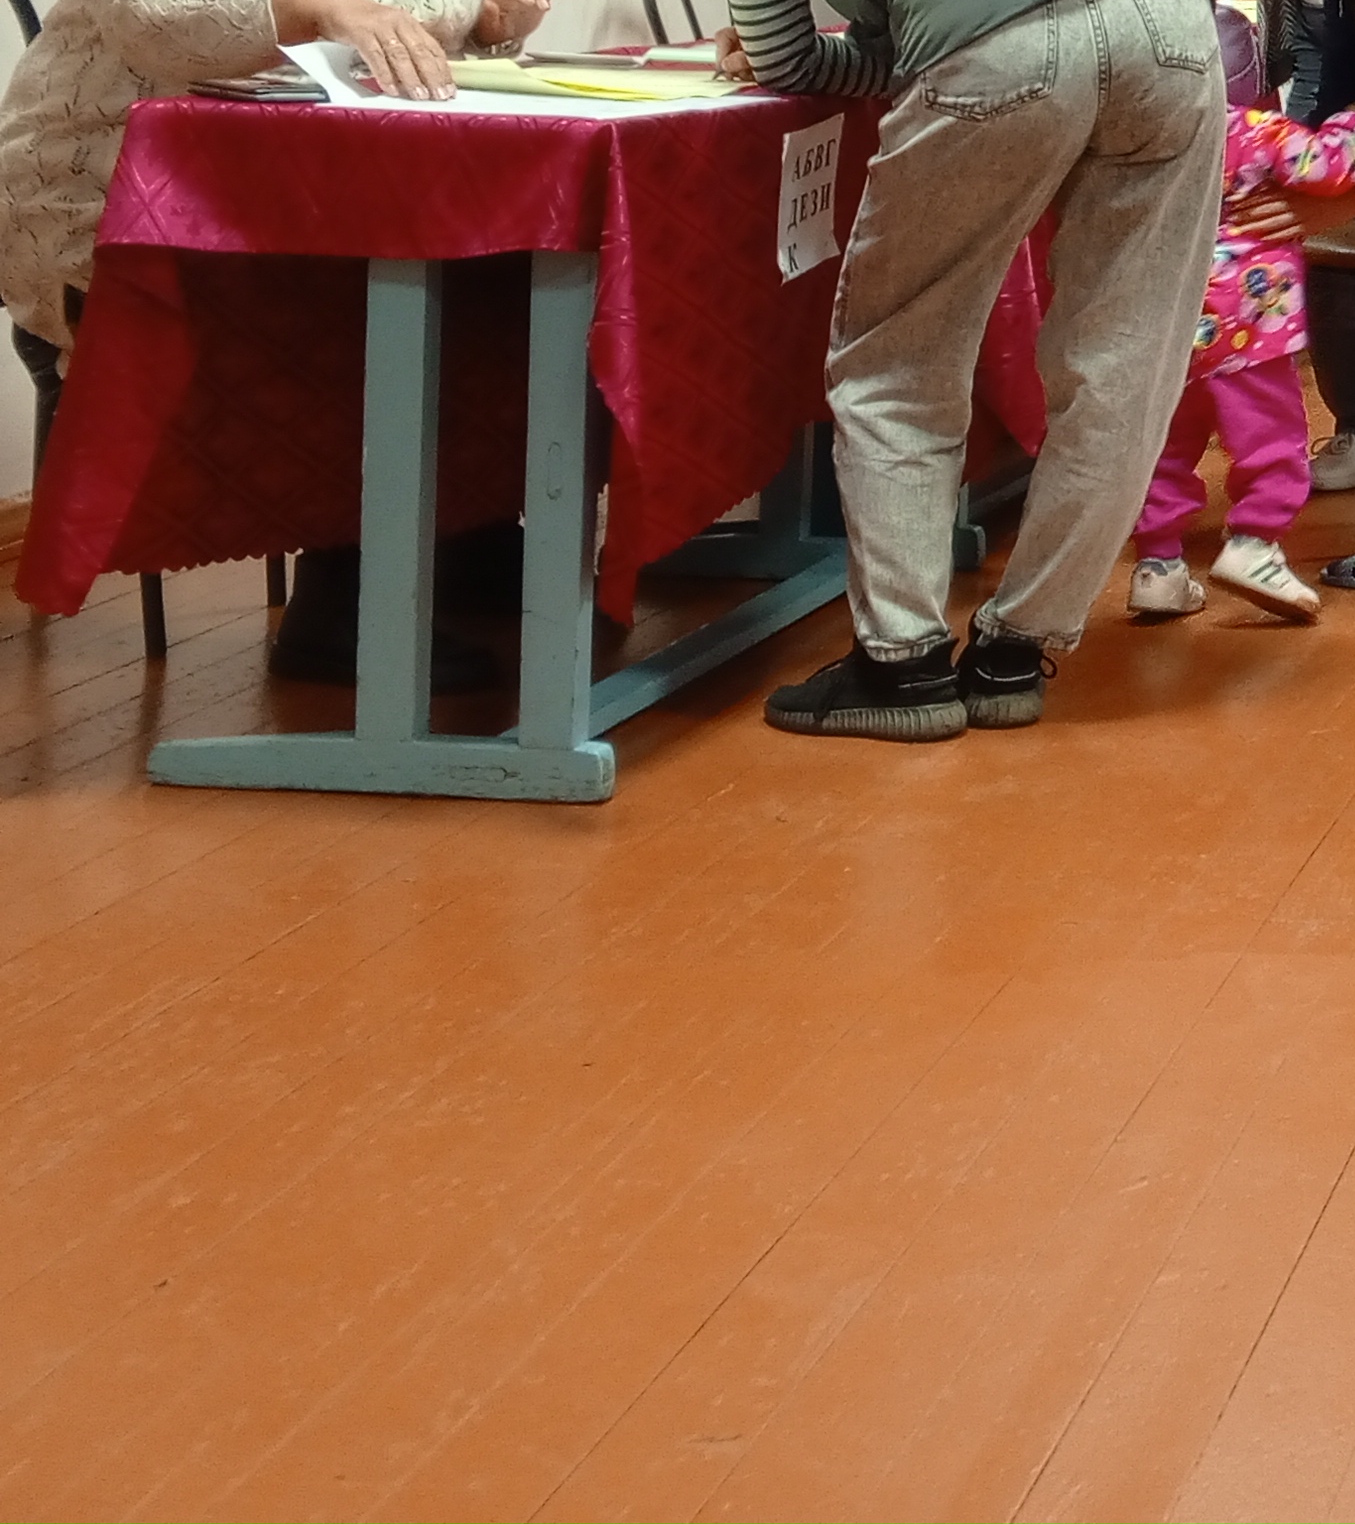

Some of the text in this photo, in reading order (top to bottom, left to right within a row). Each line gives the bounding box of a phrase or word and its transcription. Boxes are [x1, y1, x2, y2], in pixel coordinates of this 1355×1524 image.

[791, 138, 836, 182] АБВГ
[787, 182, 832, 234] ДЕЗИ
[787, 242, 799, 273] К
